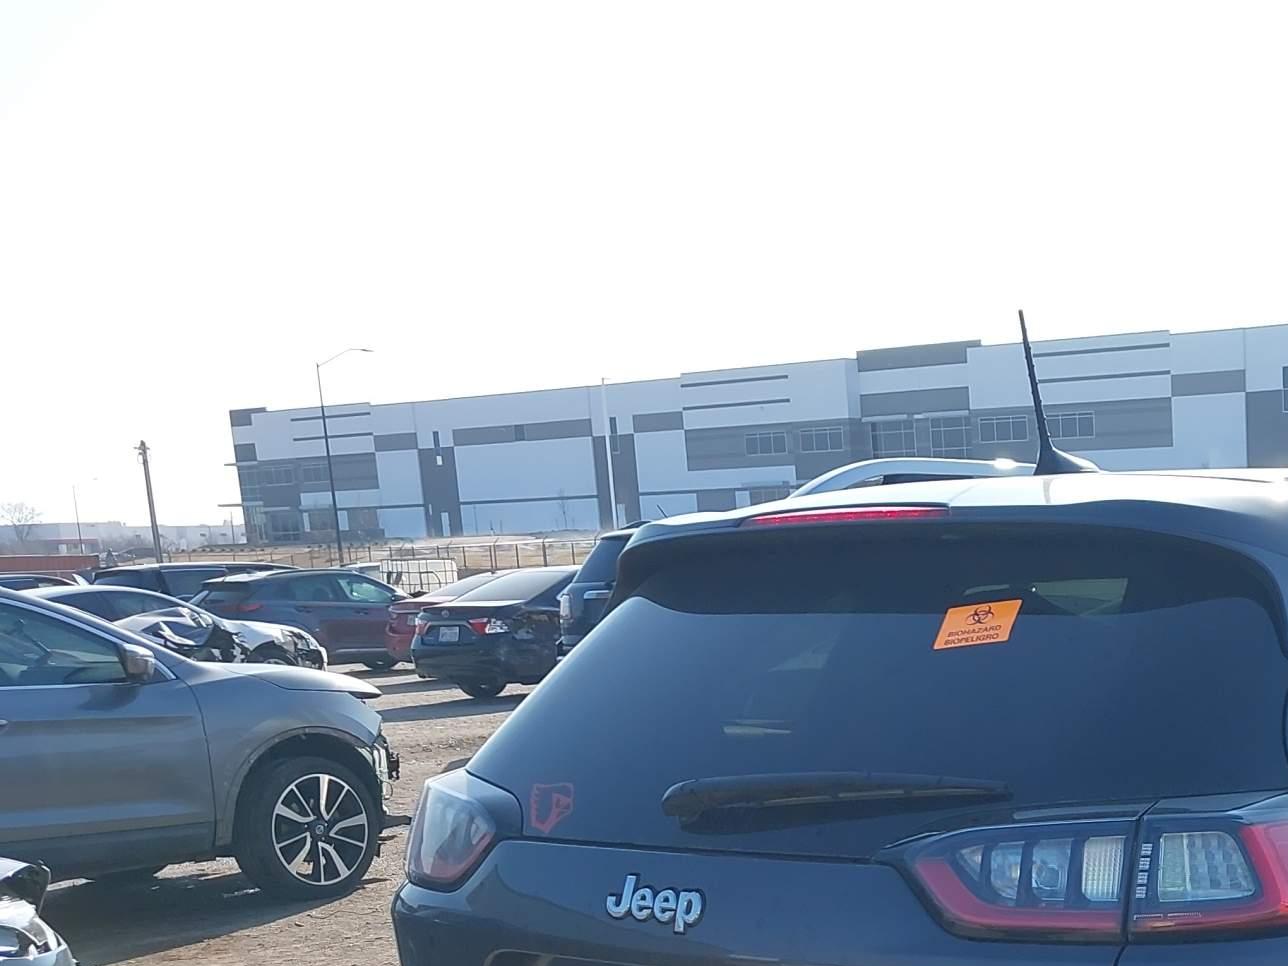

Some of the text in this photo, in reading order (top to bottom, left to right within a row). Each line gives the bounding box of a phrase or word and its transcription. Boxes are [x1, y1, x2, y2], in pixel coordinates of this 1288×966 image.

[948, 625, 1002, 638] BIOHAZARD
[944, 633, 999, 646] BIOPELIGRO
[606, 875, 702, 932] Jeep
